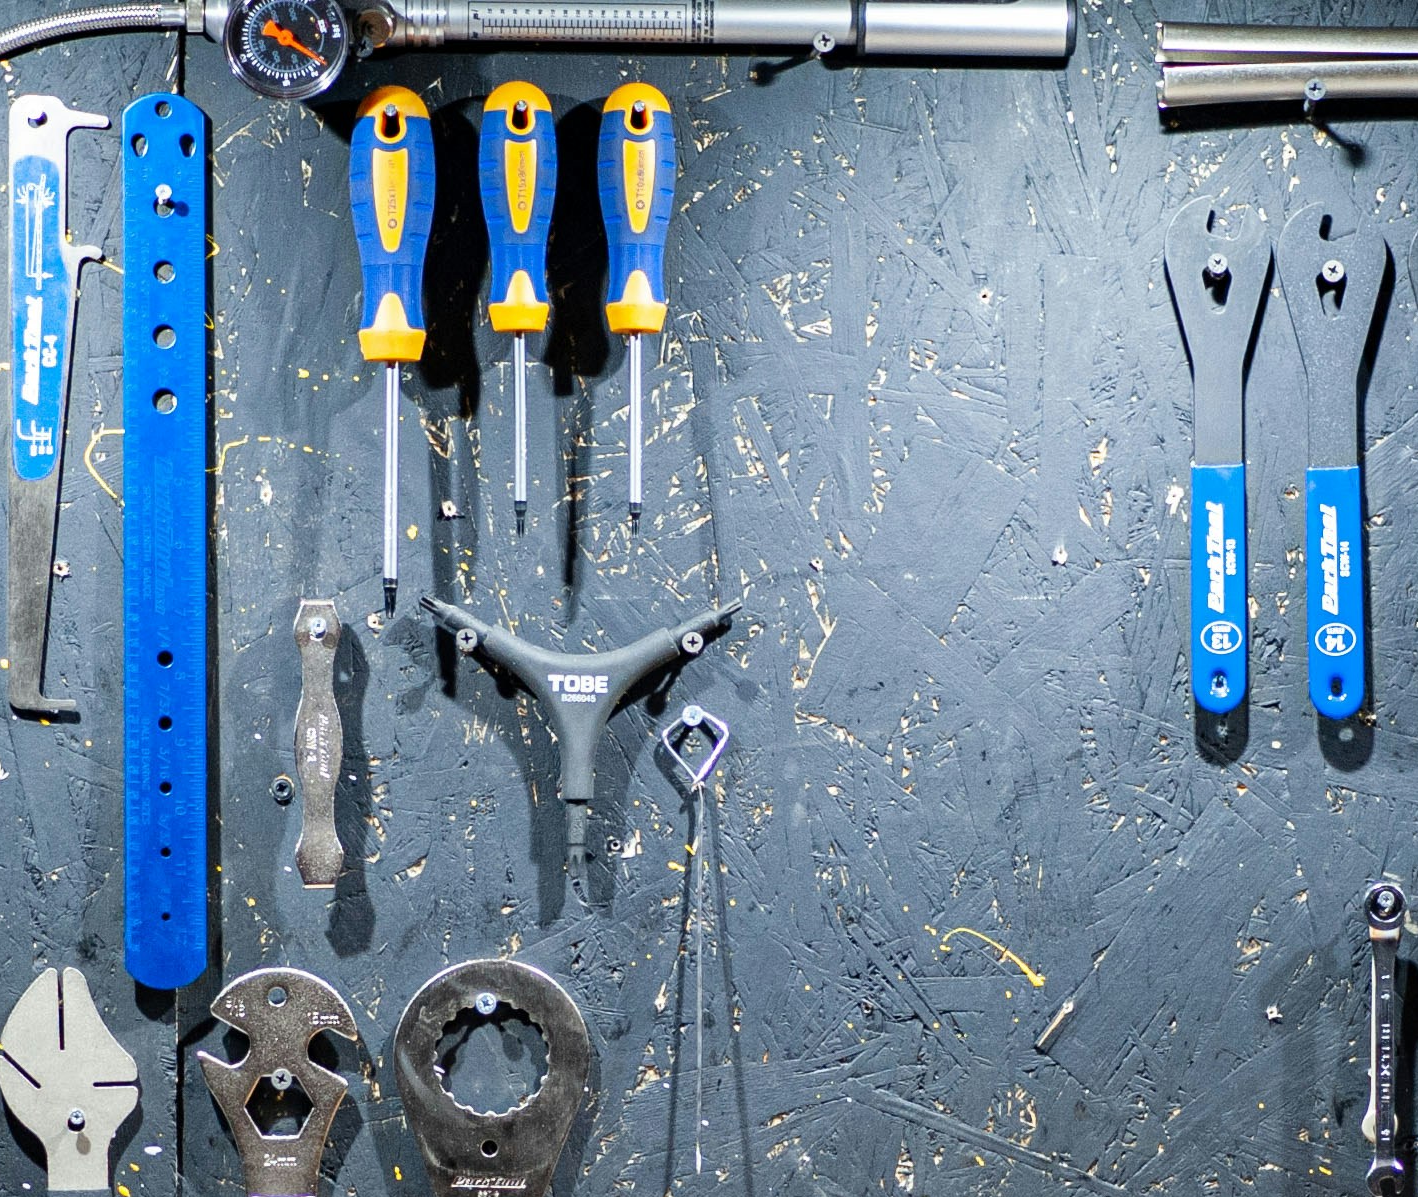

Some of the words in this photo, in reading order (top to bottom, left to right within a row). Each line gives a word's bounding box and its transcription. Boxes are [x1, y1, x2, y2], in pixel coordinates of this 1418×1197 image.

[1226, 538, 1236, 575] SCW-13
[1339, 541, 1350, 577] SCW-14
[1211, 632, 1232, 649] 13
[1324, 635, 1346, 652] 14
[547, 674, 609, 693] TOBE
